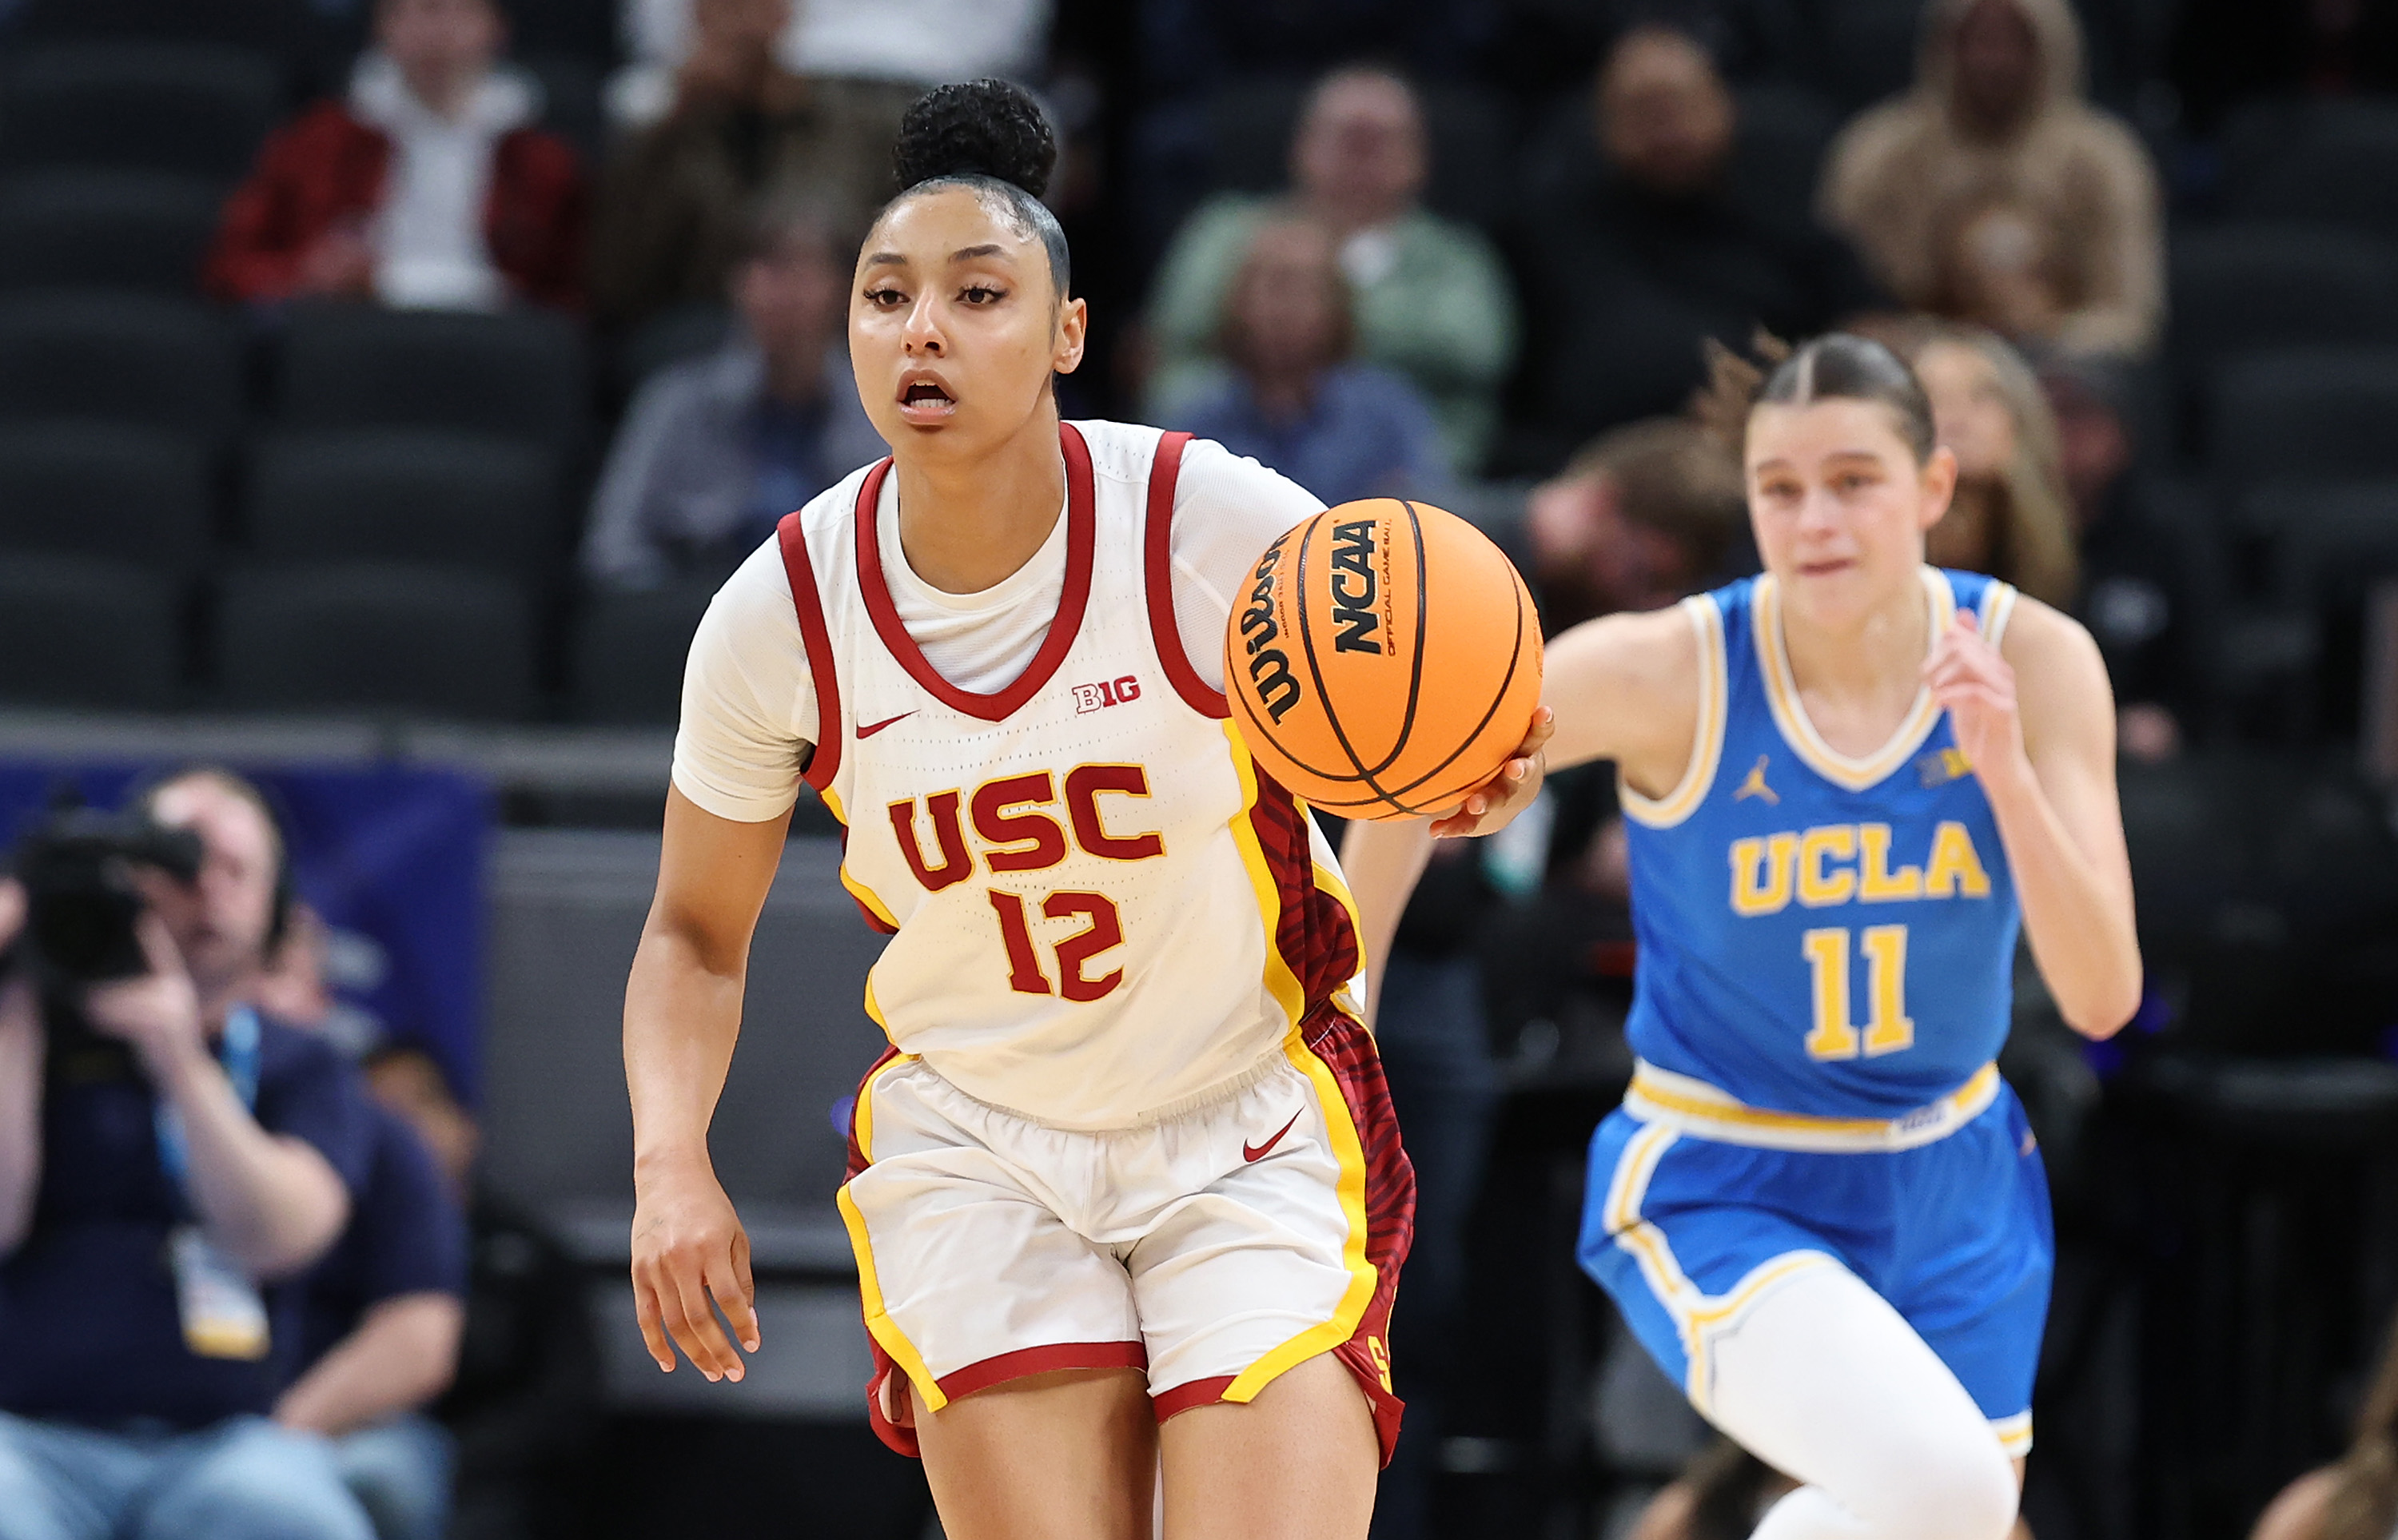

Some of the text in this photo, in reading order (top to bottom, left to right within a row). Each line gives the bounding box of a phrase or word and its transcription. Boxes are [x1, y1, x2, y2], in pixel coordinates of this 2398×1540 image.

[1331, 519, 1382, 655] NCAA
[1382, 547, 1391, 585] GAME
[1383, 589, 1396, 657] OFFICIAL
[888, 762, 1167, 893] USC
[1729, 821, 1991, 917] UCLA
[986, 888, 1125, 1003] 12
[1802, 924, 1914, 1061] 11
